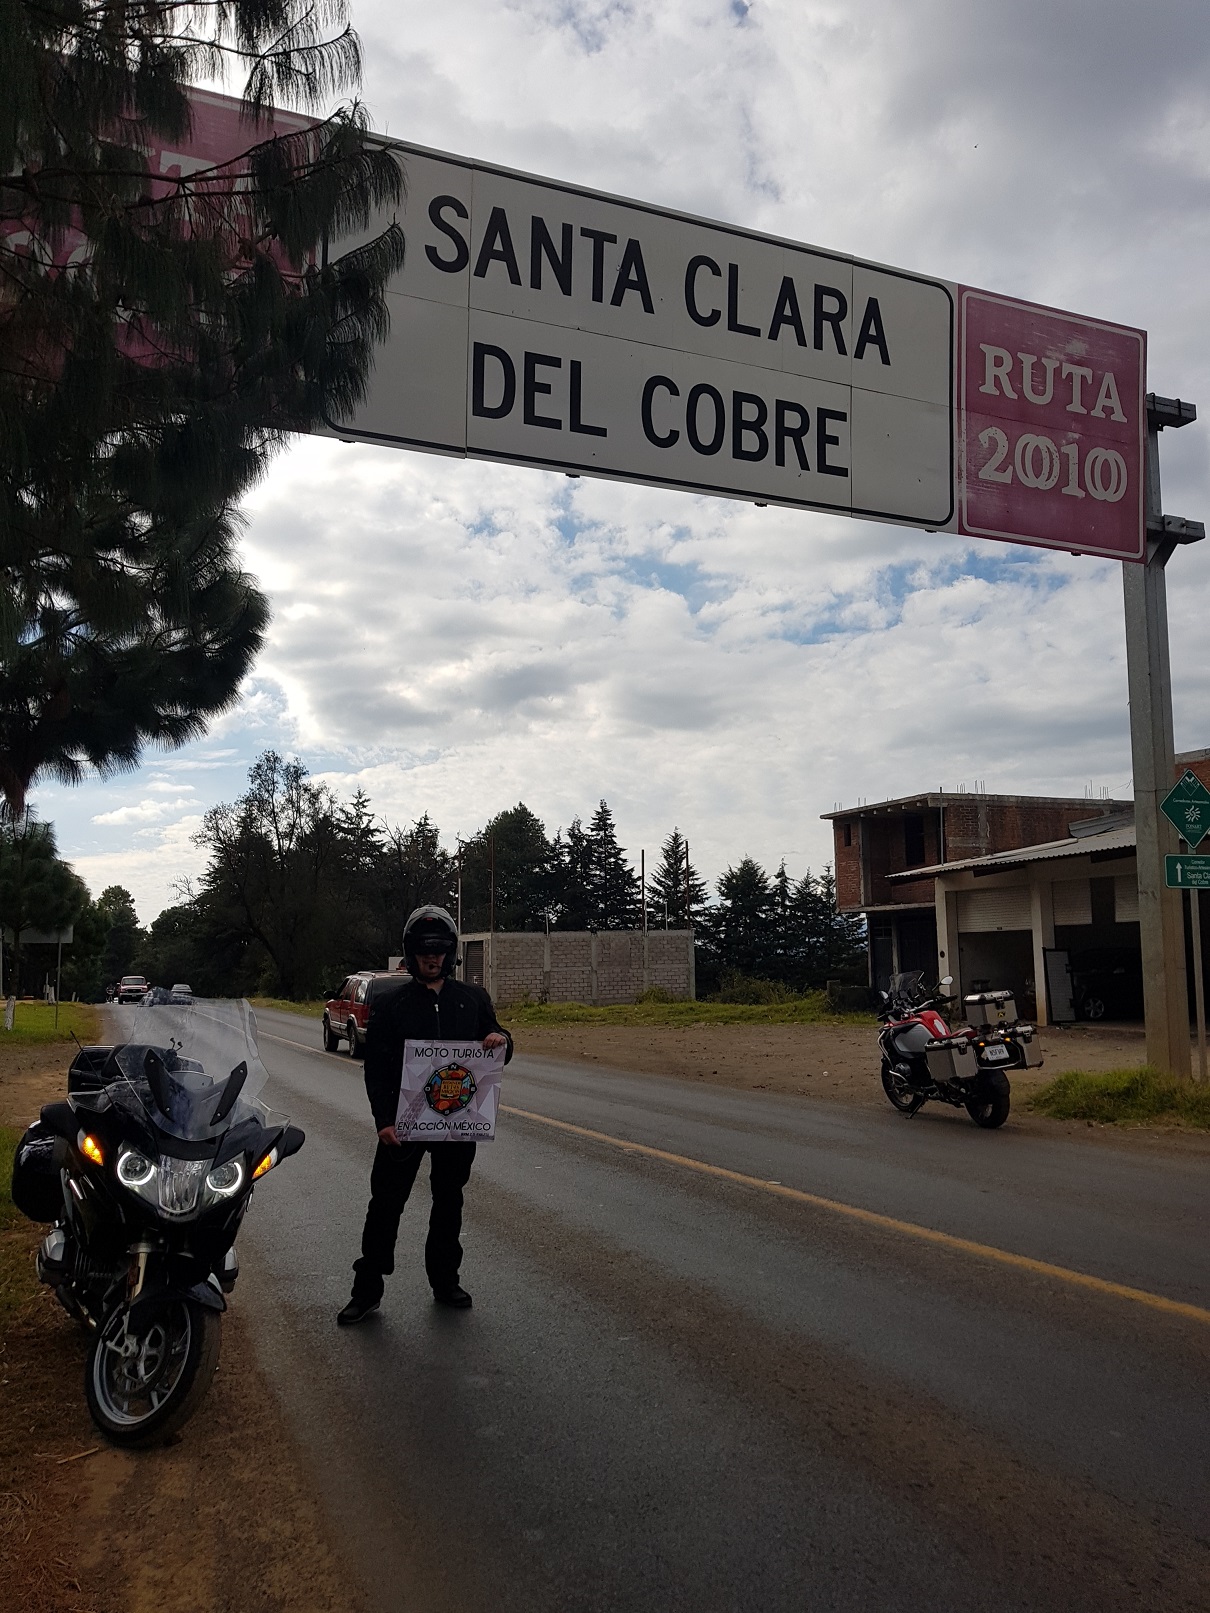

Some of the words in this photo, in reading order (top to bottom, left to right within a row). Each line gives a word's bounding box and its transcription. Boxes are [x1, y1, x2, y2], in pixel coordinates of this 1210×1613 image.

[425, 195, 655, 314] SANTA
[685, 255, 891, 366] CLARA
[472, 341, 607, 437] DEL
[641, 375, 848, 477] COBRE
[979, 343, 1128, 423] RUTA
[978, 427, 1128, 502] 2010
[415, 1047, 449, 1059] MOTO
[452, 1048, 494, 1059] TURISTA
[397, 1121, 410, 1131] EN
[412, 1119, 451, 1131] ACCIÓN
[453, 1119, 491, 1132] MÉXICO
